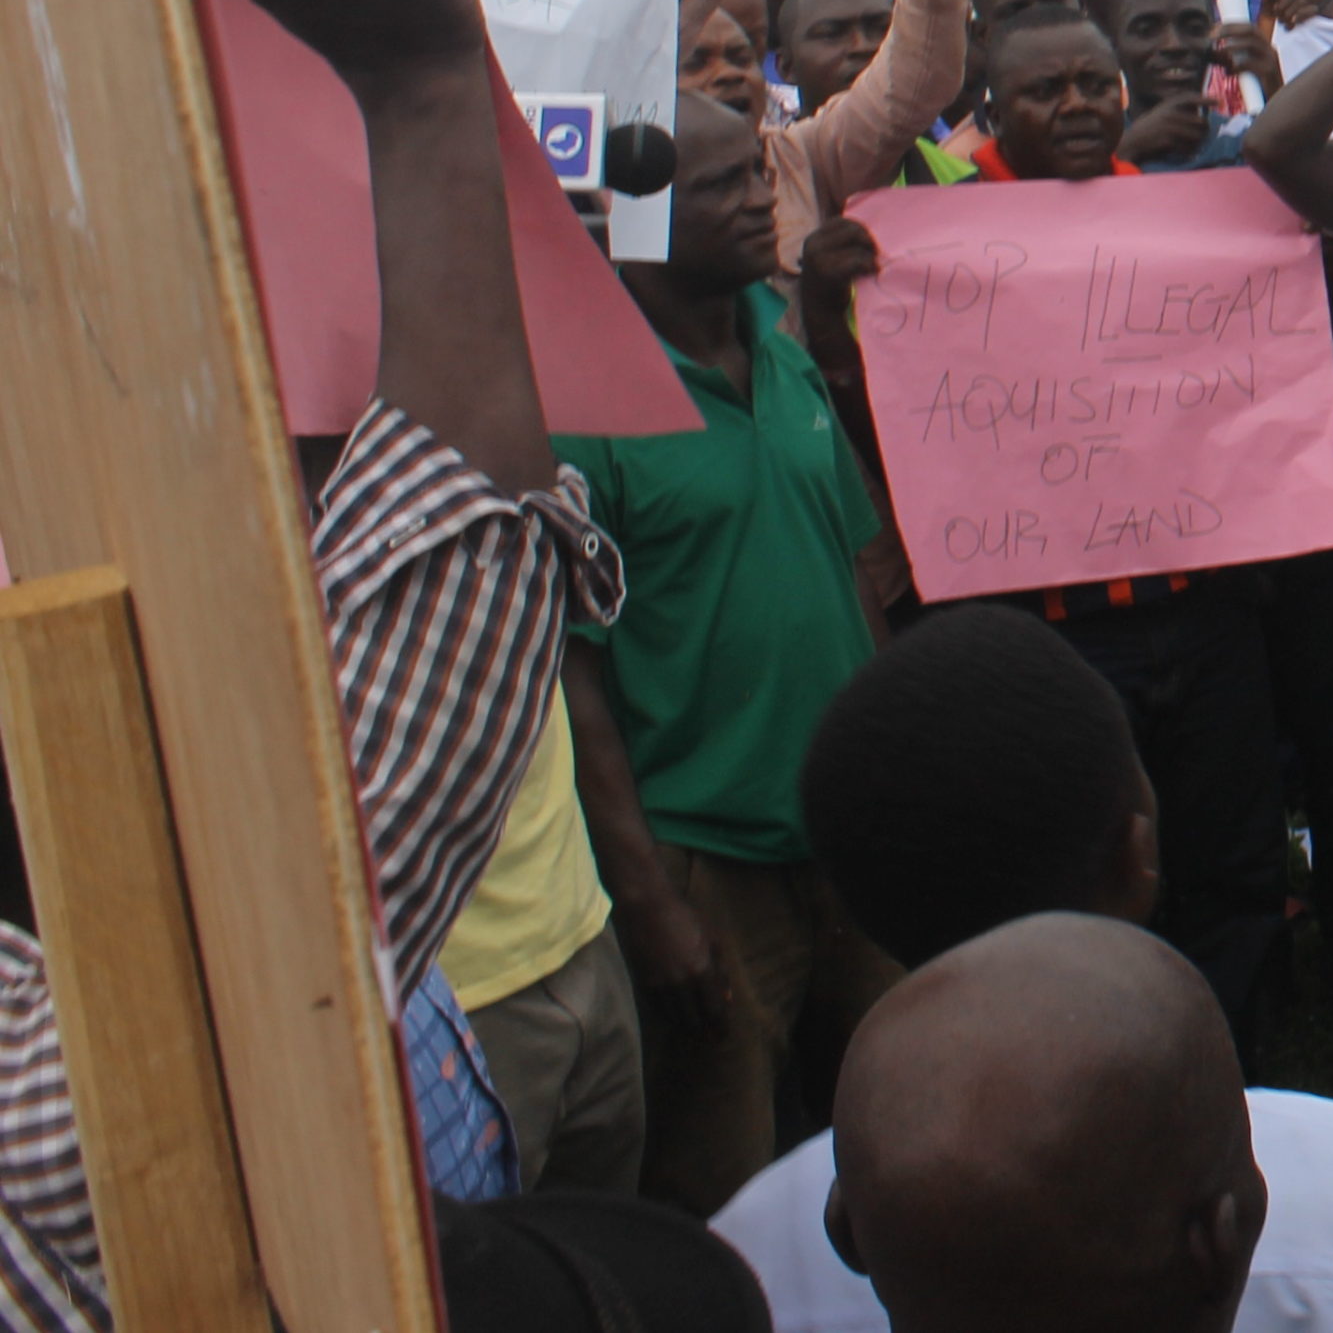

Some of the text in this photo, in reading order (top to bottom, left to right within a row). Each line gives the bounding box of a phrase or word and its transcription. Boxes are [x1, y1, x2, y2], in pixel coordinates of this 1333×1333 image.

[873, 241, 1318, 353] STOP ILLEGAL
[906, 352, 1257, 451] AQUISITION
[1038, 432, 1123, 486] OF
[944, 487, 1224, 564] OUR LAND
